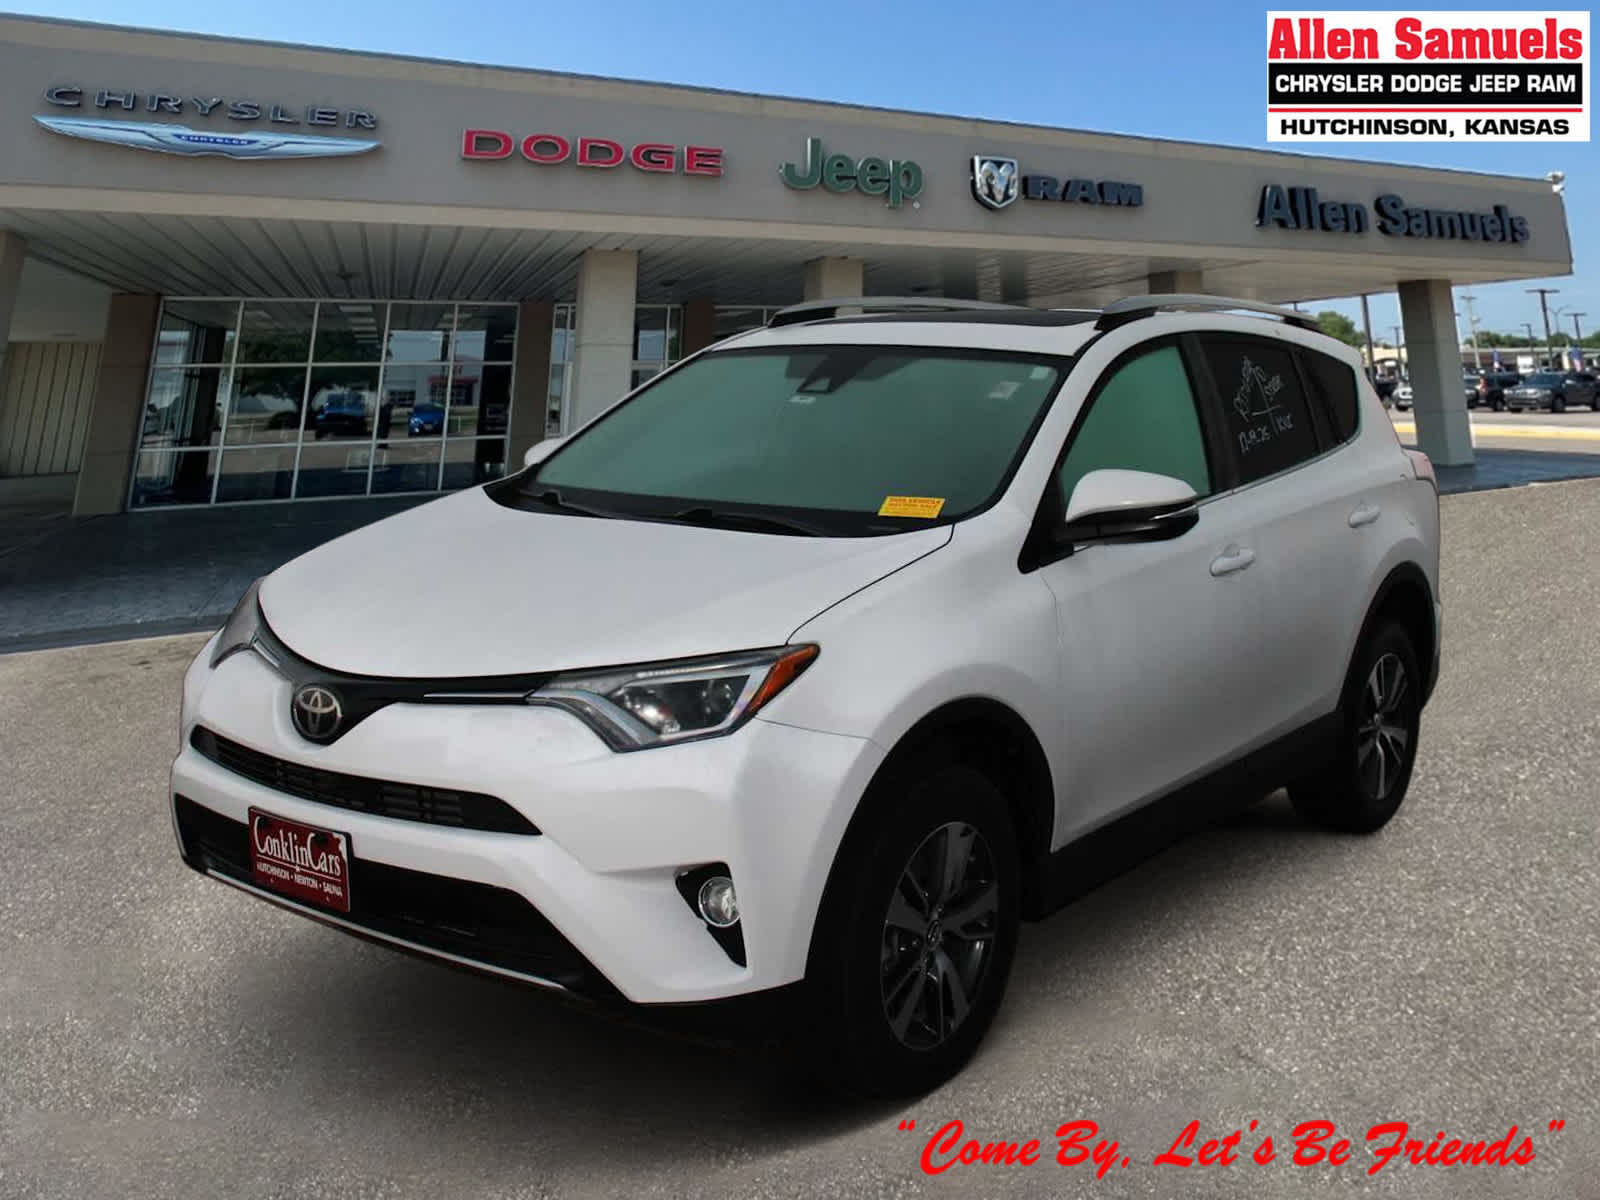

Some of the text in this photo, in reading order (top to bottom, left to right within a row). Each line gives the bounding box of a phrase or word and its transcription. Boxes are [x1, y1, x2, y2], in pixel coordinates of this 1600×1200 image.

[43, 86, 378, 129] CHRYSLER
[461, 128, 724, 177] DODGE
[780, 137, 923, 208] Jeep
[1022, 174, 1144, 207] RAM
[1255, 184, 1530, 243] Allen Samuels
